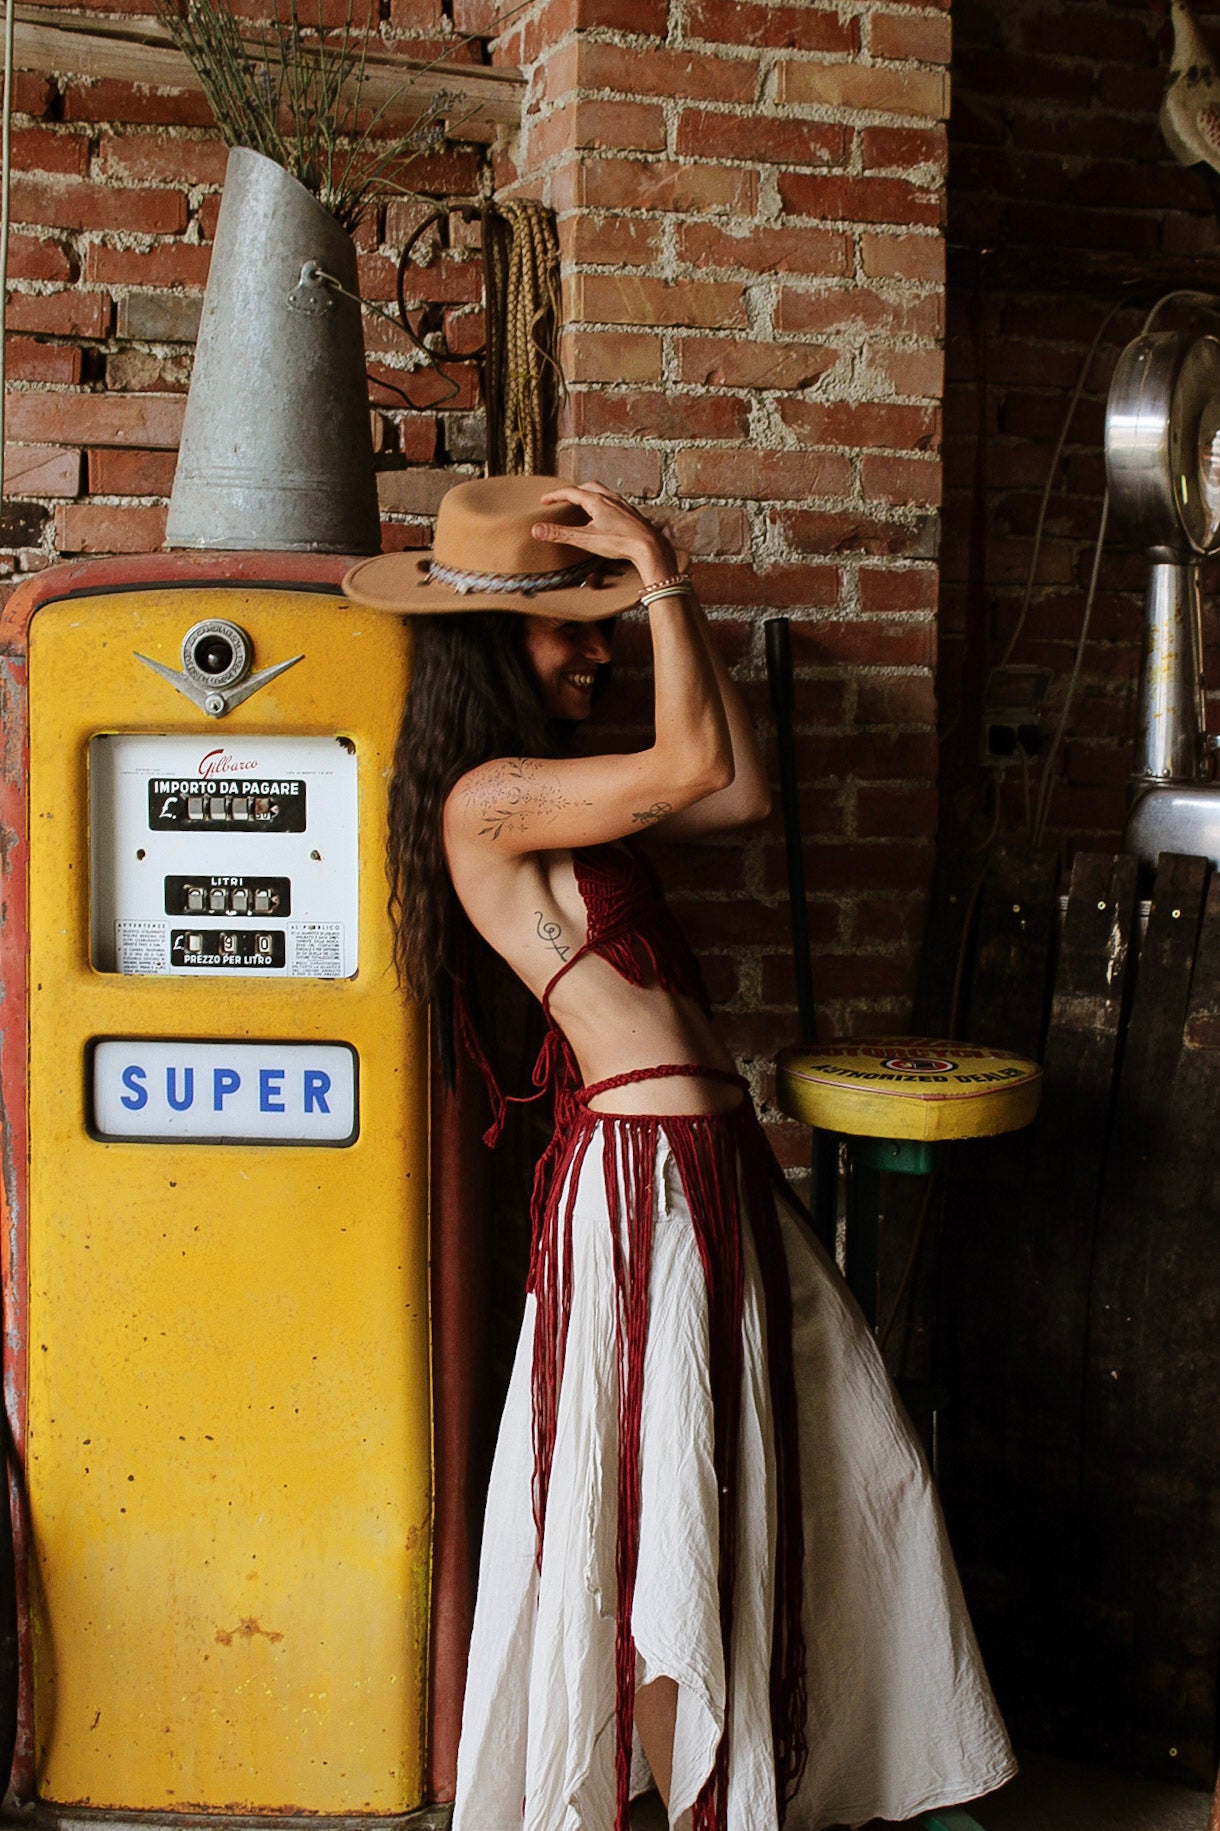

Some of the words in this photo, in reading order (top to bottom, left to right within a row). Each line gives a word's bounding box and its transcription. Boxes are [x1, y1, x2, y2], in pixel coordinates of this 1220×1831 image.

[198, 749, 258, 779] Gilbarco
[154, 781, 217, 794] IMPORTO
[219, 782, 239, 794] DA
[242, 782, 299, 795] PAGARE
[211, 877, 243, 886] LITRI
[184, 954, 220, 964] PREZZO
[222, 954, 242, 965] PER
[244, 955, 273, 965] LITRO
[811, 1064, 948, 1083] AUTHORIZED
[953, 1068, 1026, 1083] DEALER
[120, 1065, 331, 1114] SUPER
